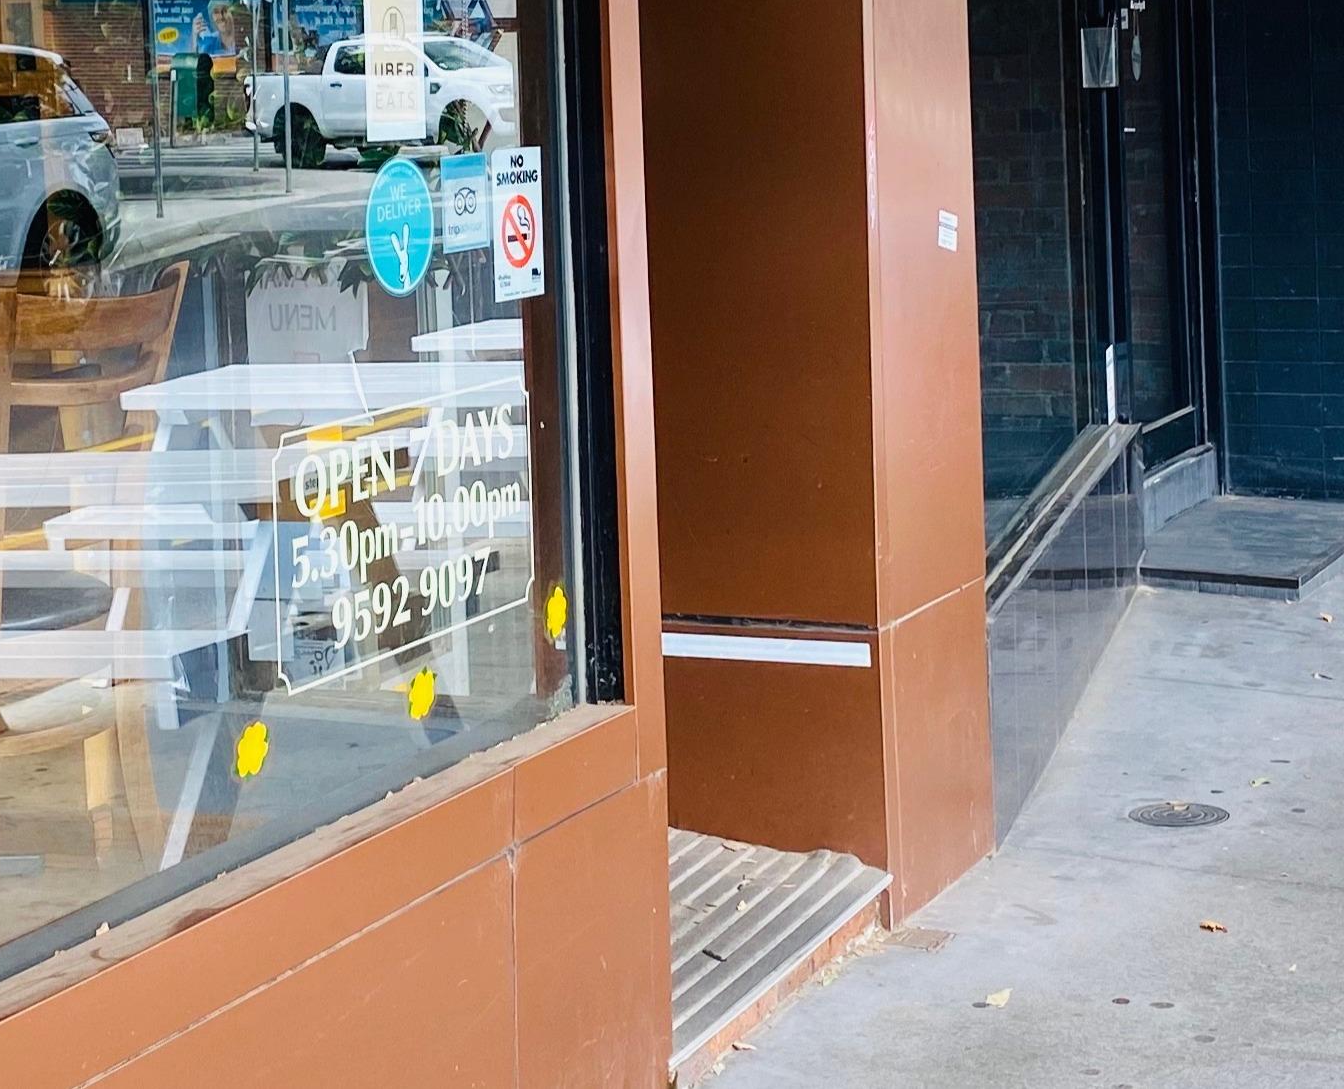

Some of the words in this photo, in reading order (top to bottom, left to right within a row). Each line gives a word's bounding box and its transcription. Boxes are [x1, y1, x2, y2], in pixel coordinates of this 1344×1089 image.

[375, 91, 416, 111] EATS
[510, 154, 524, 168] NO
[496, 169, 538, 186] SMOKING
[390, 182, 408, 201] WE
[376, 196, 422, 222] DELIVER
[295, 436, 397, 519] OPEN
[409, 426, 434, 487] 7
[437, 403, 513, 478] DAYS
[331, 576, 411, 650] 9592
[419, 546, 492, 617] 9097
